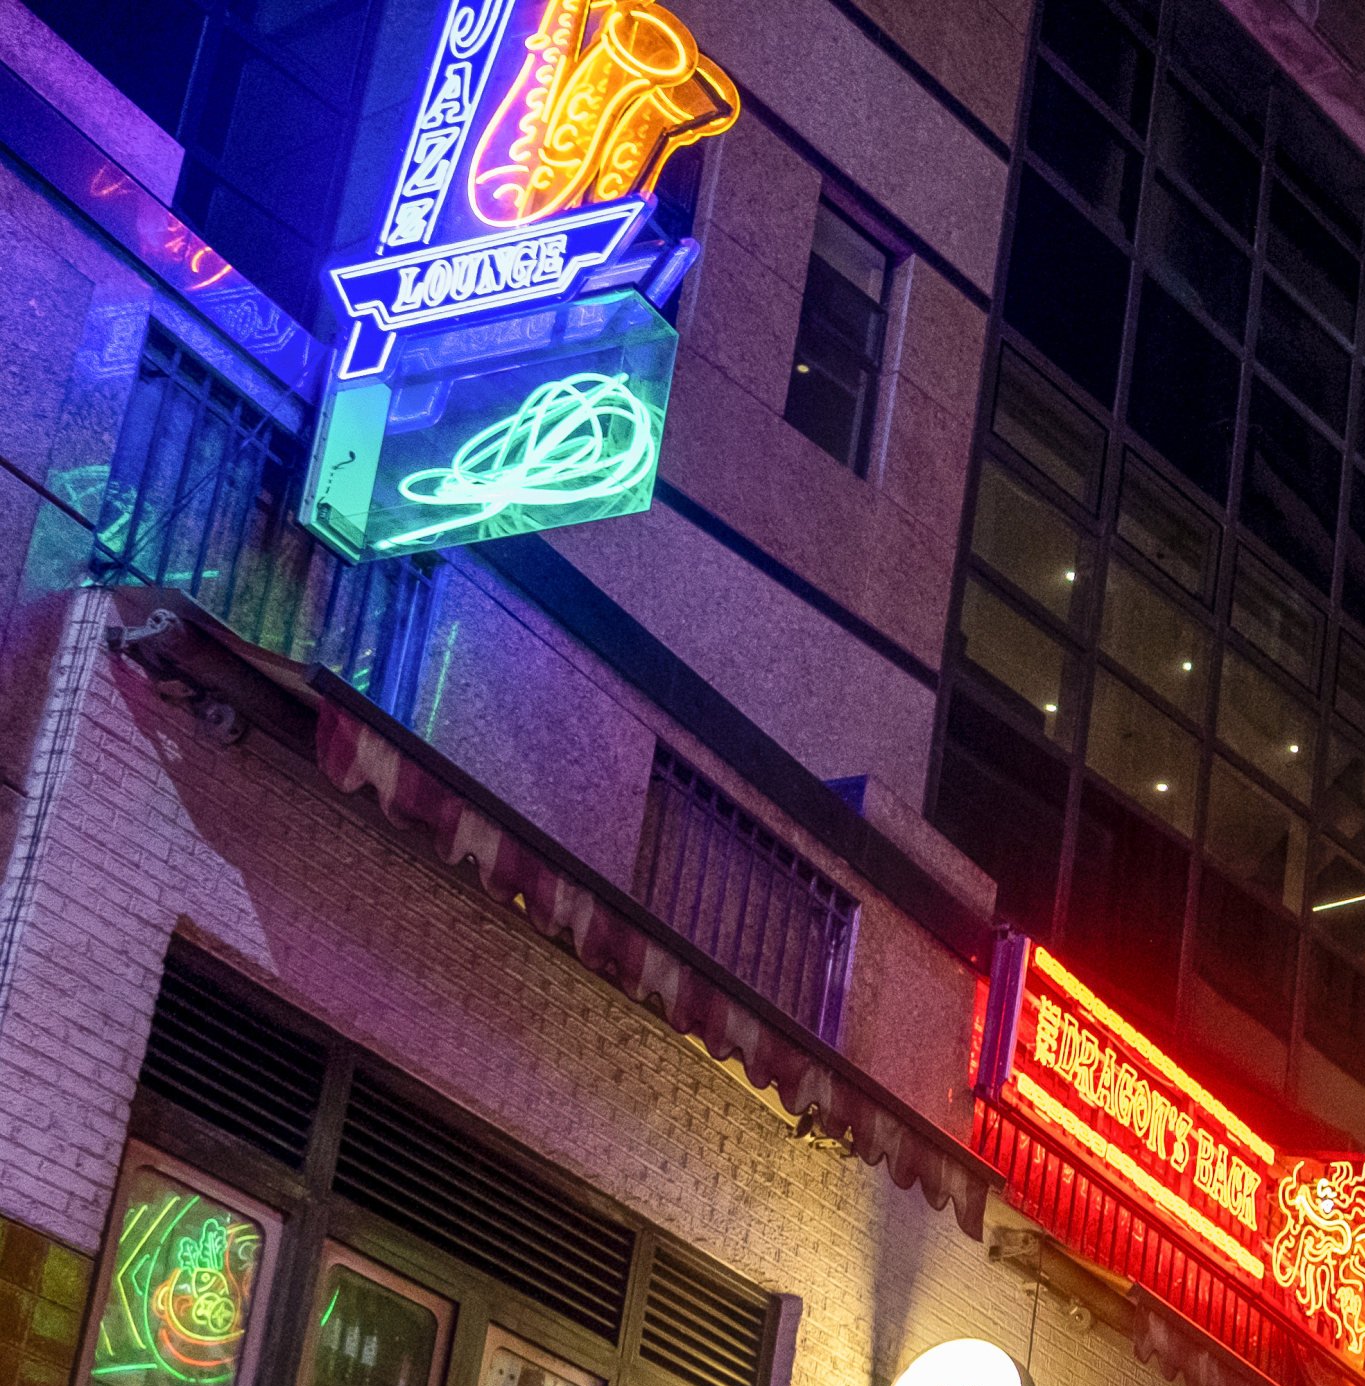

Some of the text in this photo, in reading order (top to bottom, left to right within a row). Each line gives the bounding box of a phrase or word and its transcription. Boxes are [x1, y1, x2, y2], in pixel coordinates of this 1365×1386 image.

[387, 0, 497, 247] JAZZ
[391, 234, 568, 313] LOUNGE
[1054, 1012, 1262, 1232] DRAGON'S BACK
